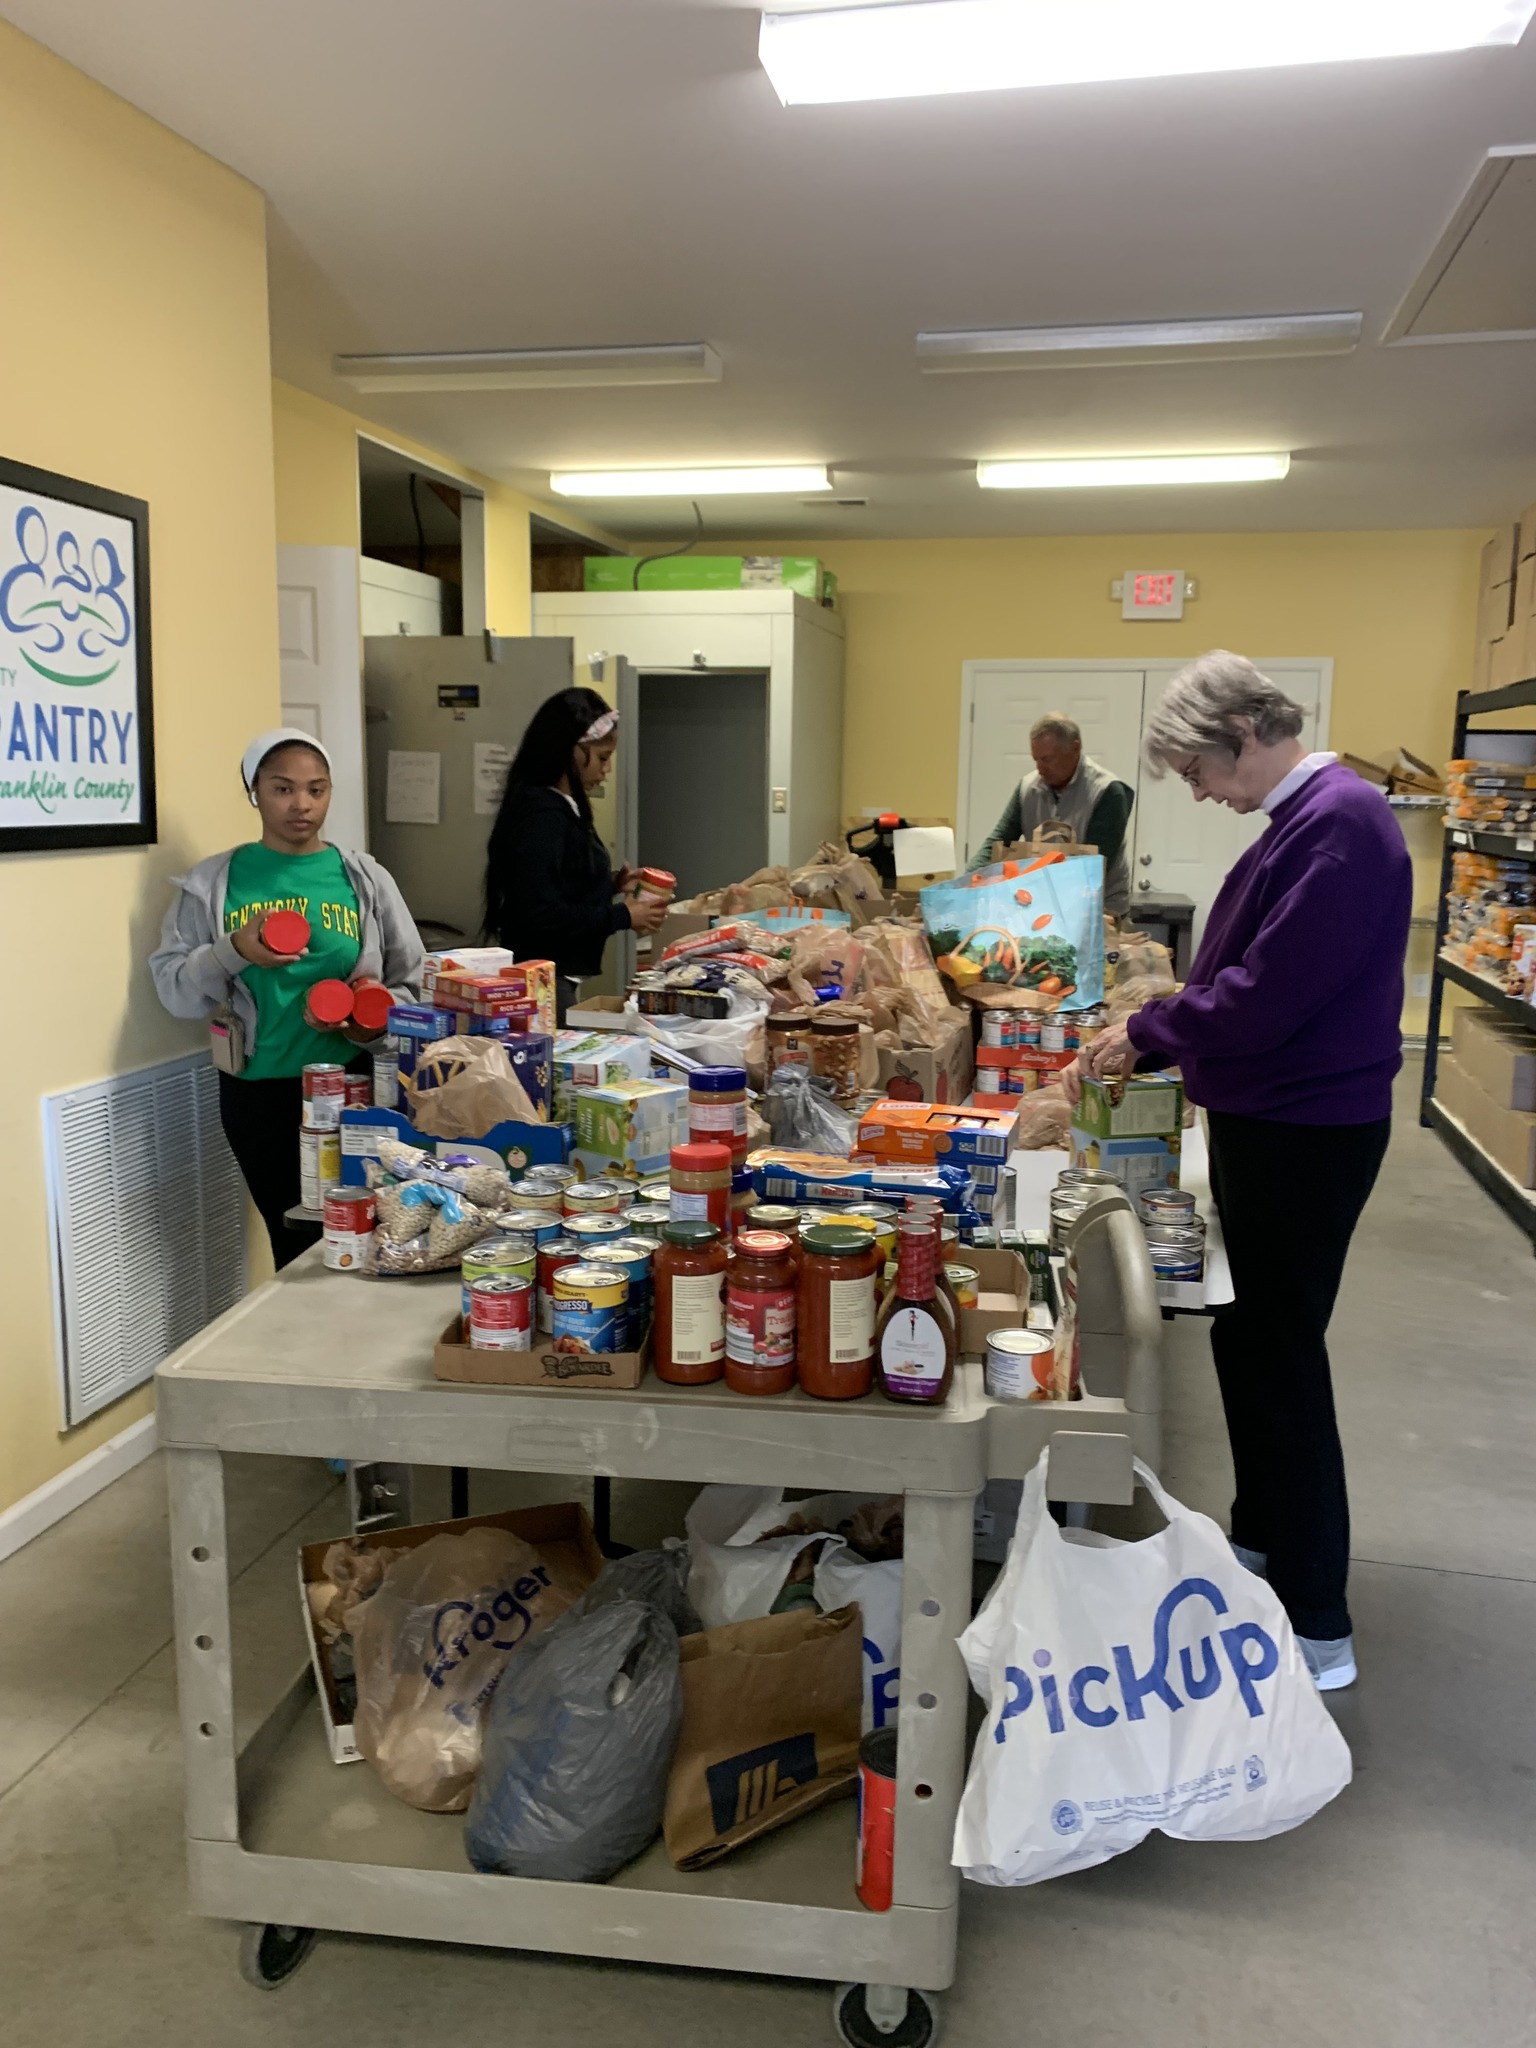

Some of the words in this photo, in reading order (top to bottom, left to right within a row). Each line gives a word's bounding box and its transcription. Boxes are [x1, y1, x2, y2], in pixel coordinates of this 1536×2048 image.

[1134, 574, 1176, 606] EXIT
[0, 701, 133, 764] ANTRY
[0, 770, 68, 814] anklin
[73, 776, 135, 813] County
[321, 902, 360, 942] STAT
[554, 1300, 588, 1311] OGRESSO
[423, 1565, 552, 1689] Kroger
